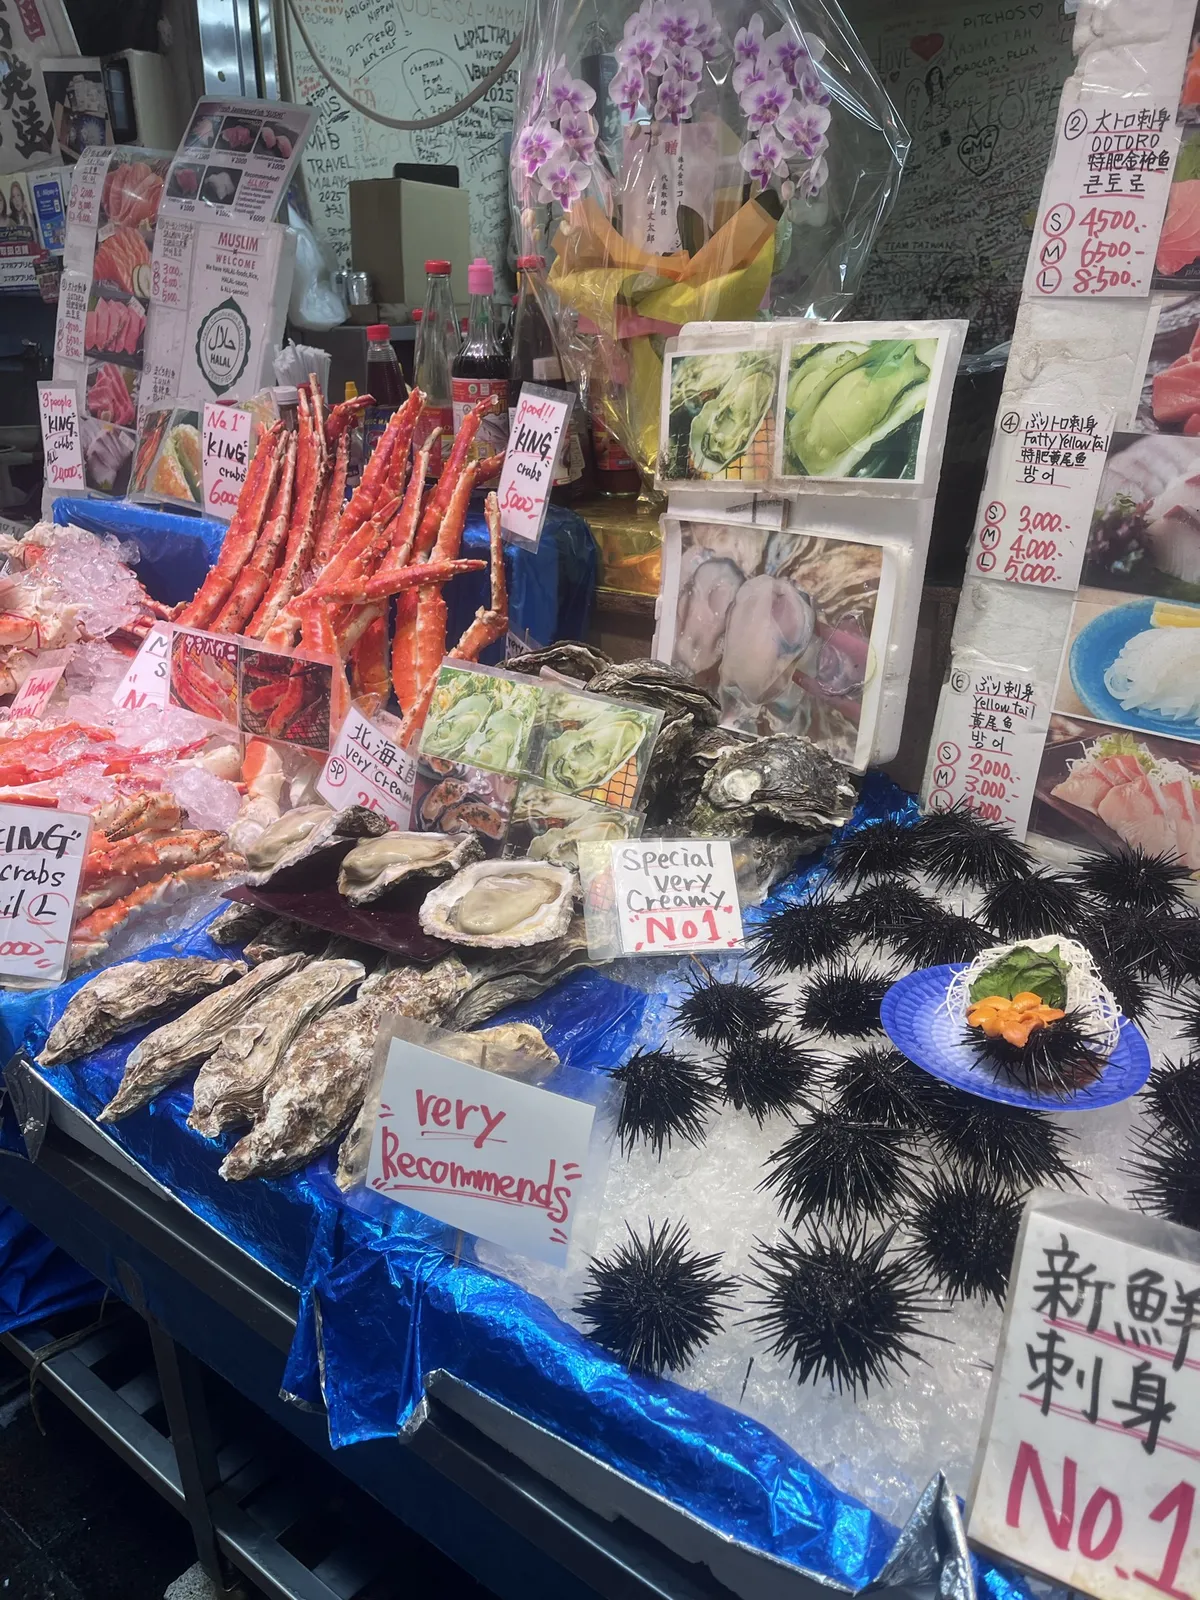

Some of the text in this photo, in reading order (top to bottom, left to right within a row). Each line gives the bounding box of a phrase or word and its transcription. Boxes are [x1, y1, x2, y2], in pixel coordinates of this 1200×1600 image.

[1094, 108, 1171, 133] 大トロ刺身
[664, 139, 679, 156] 贈
[267, 162, 286, 171] ¥1000
[307, 156, 353, 175] TRAVEL
[1087, 150, 1171, 172] 特肥金枪鱼
[319, 191, 347, 203] 2025
[660, 174, 668, 216] 代表取締役
[218, 232, 259, 252] MUSLIM
[216, 254, 256, 270] WELCOME
[208, 325, 236, 351] حلال
[210, 353, 231, 368] HALAL
[50, 395, 72, 414] people
[1025, 411, 1098, 436] ぶりトロ刺身
[1023, 431, 1058, 451] Fatty
[1021, 448, 1087, 467] 特肥黄尾鱼
[517, 462, 542, 481] crabs
[185, 635, 237, 661] タラバガニ
[975, 676, 1034, 702] ぶり刺身
[973, 695, 1010, 714] Yellow
[971, 713, 1014, 733] 黄尾鱼
[350, 723, 415, 788] 北海道
[0, 824, 77, 859] ING
[622, 843, 714, 876] Special
[0, 858, 65, 887] crabs
[627, 889, 726, 913] Creamy
[381, 1126, 571, 1223] Recommends
[1032, 1232, 1200, 1371] 新鮮
[1026, 1328, 1176, 1455] 刺身
